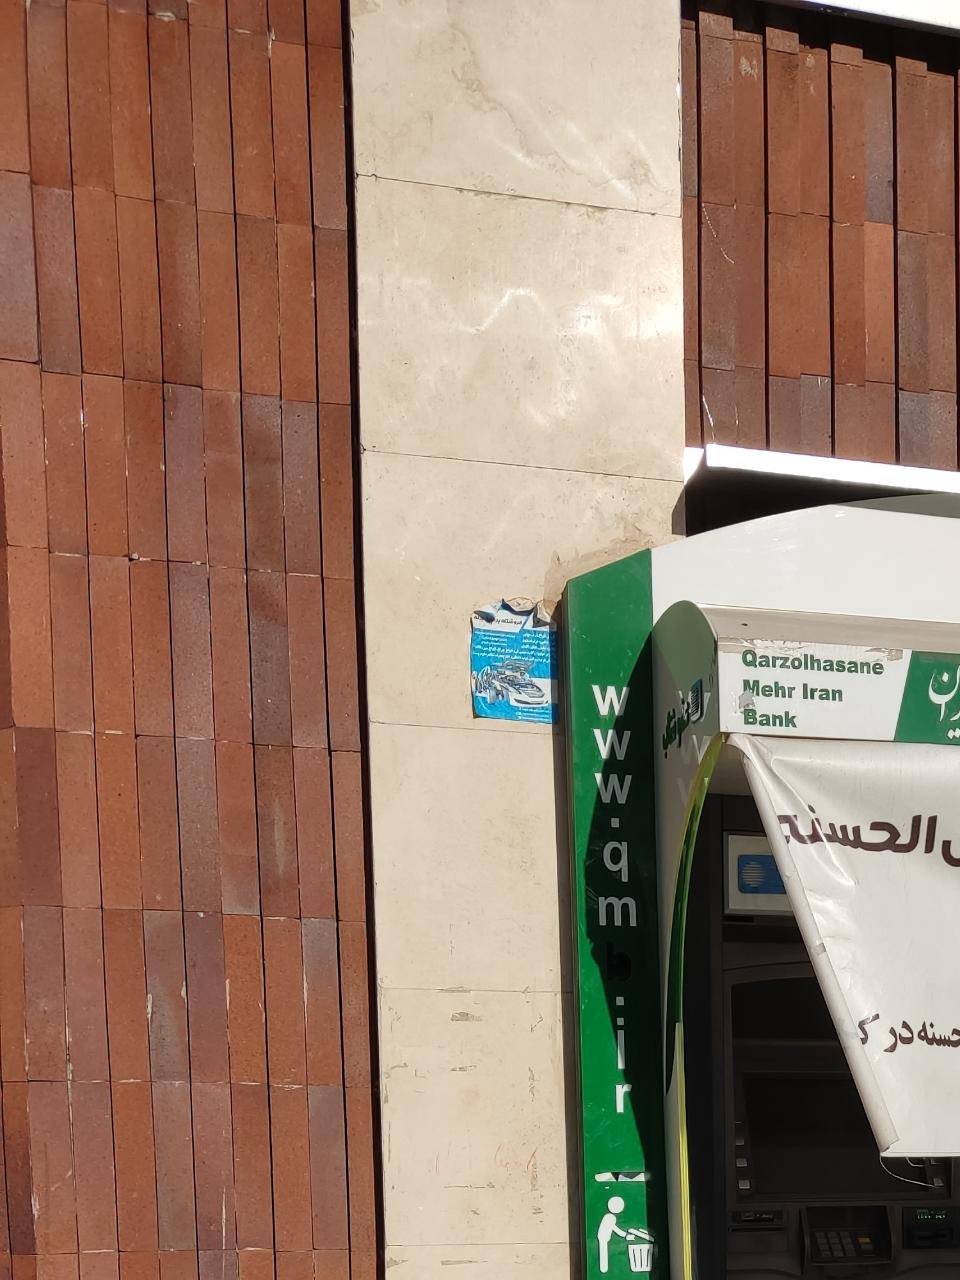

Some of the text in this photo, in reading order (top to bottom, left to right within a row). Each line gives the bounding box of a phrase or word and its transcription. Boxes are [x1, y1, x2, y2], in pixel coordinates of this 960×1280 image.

[742, 649, 884, 675] Qarzolhasane
[742, 679, 843, 701] Mehr Iran
[743, 708, 798, 728] Bank
[883, 1020, 914, 1053] در
